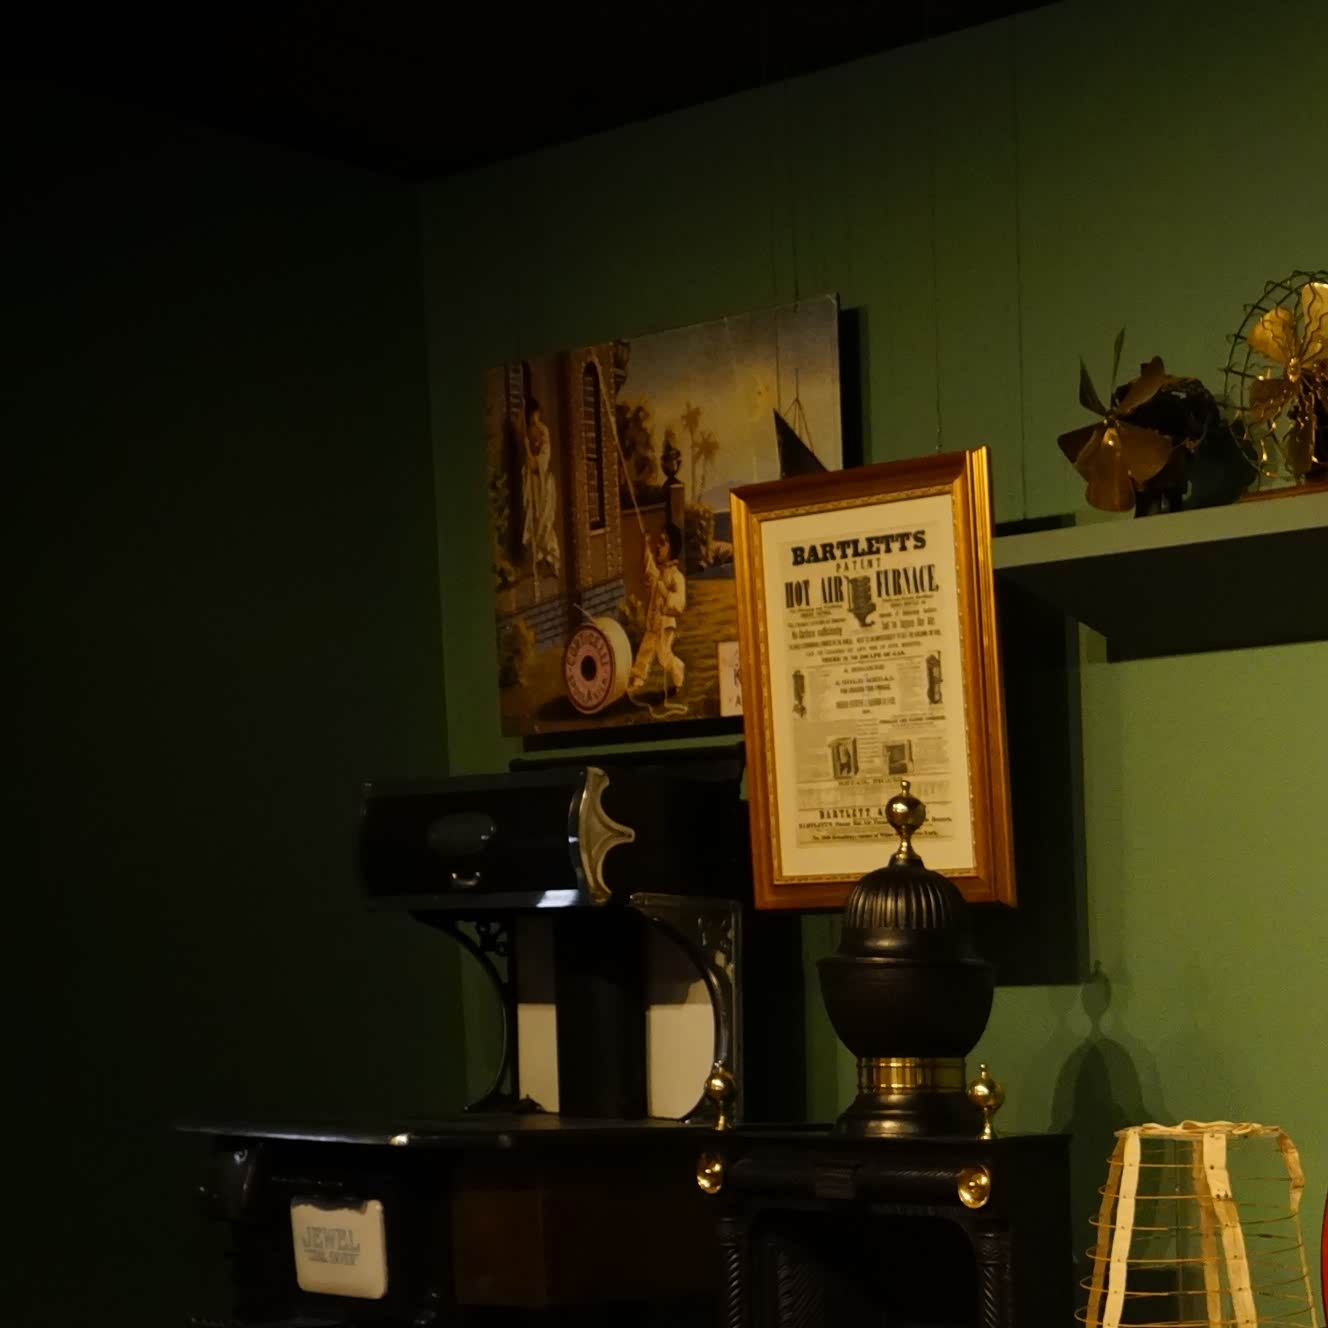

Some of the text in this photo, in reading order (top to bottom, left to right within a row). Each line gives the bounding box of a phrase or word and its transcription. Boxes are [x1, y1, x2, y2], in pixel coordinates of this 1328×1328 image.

[836, 558, 881, 573] PATENT
[785, 580, 810, 608] HOT
[821, 576, 844, 604] AIR
